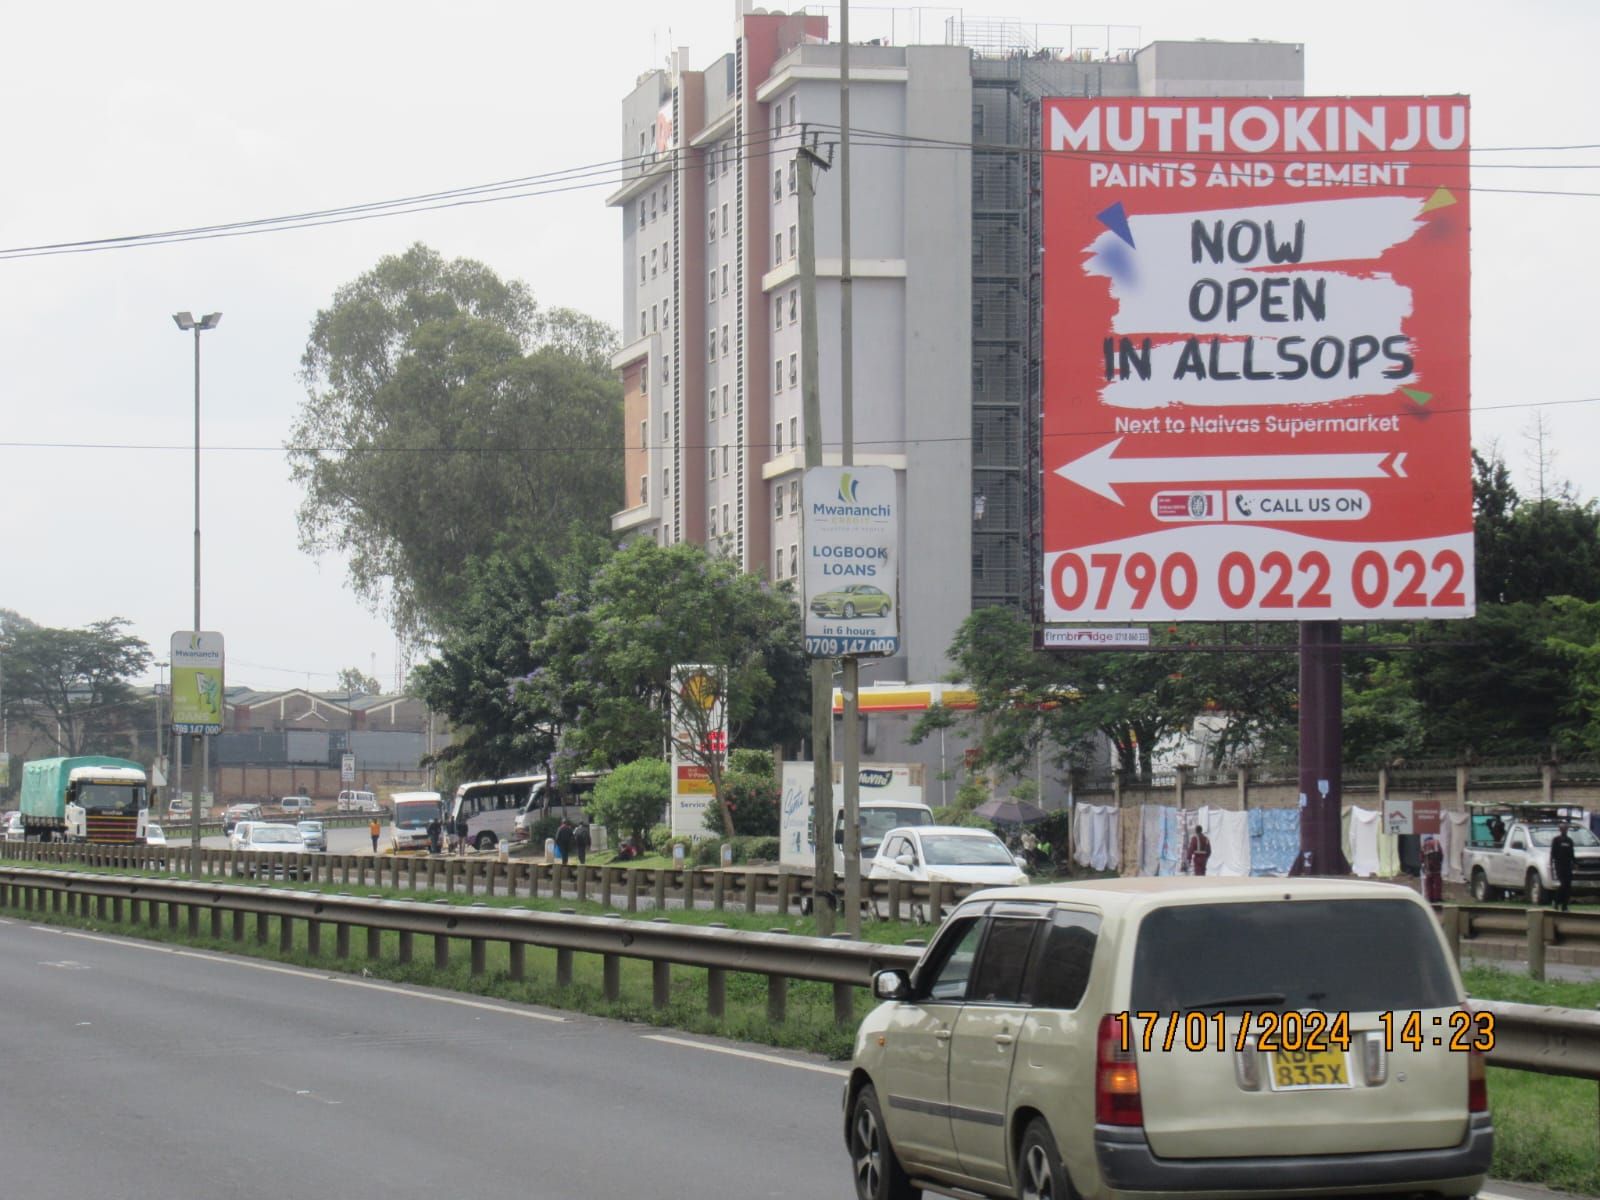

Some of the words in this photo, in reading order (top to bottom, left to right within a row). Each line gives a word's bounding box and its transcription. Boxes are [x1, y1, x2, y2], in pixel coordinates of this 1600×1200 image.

[1050, 105, 1465, 152] MUTHOKINJU
[1090, 162, 1197, 188] PAINTS
[1206, 162, 1275, 188] AND
[1284, 162, 1410, 188] CEMENT
[1190, 219, 1306, 265] NOW
[1188, 277, 1326, 322] OPEN
[1103, 337, 1152, 382] IN
[1173, 335, 1415, 381] ALLSOPS
[1115, 416, 1161, 434] Next
[1165, 416, 1185, 434] to
[1190, 415, 1260, 433] Naivas
[1266, 414, 1399, 438] Supermarket
[813, 503, 891, 517] Mwananchi
[1260, 498, 1304, 513] CALL
[1308, 498, 1331, 513] US
[1335, 497, 1363, 512] ON
[812, 545, 888, 559] LOGBOOK
[823, 564, 876, 576] LOANS
[1050, 551, 1199, 611] 0790
[1218, 550, 1332, 610] 022
[1351, 549, 1466, 608] 022
[823, 625, 833, 635] in
[837, 626, 843, 635] 6
[846, 626, 876, 635] hours
[806, 638, 838, 655] 0709
[841, 639, 867, 654] 147
[869, 640, 895, 652] 000
[1278, 1064, 1343, 1086] 835X
